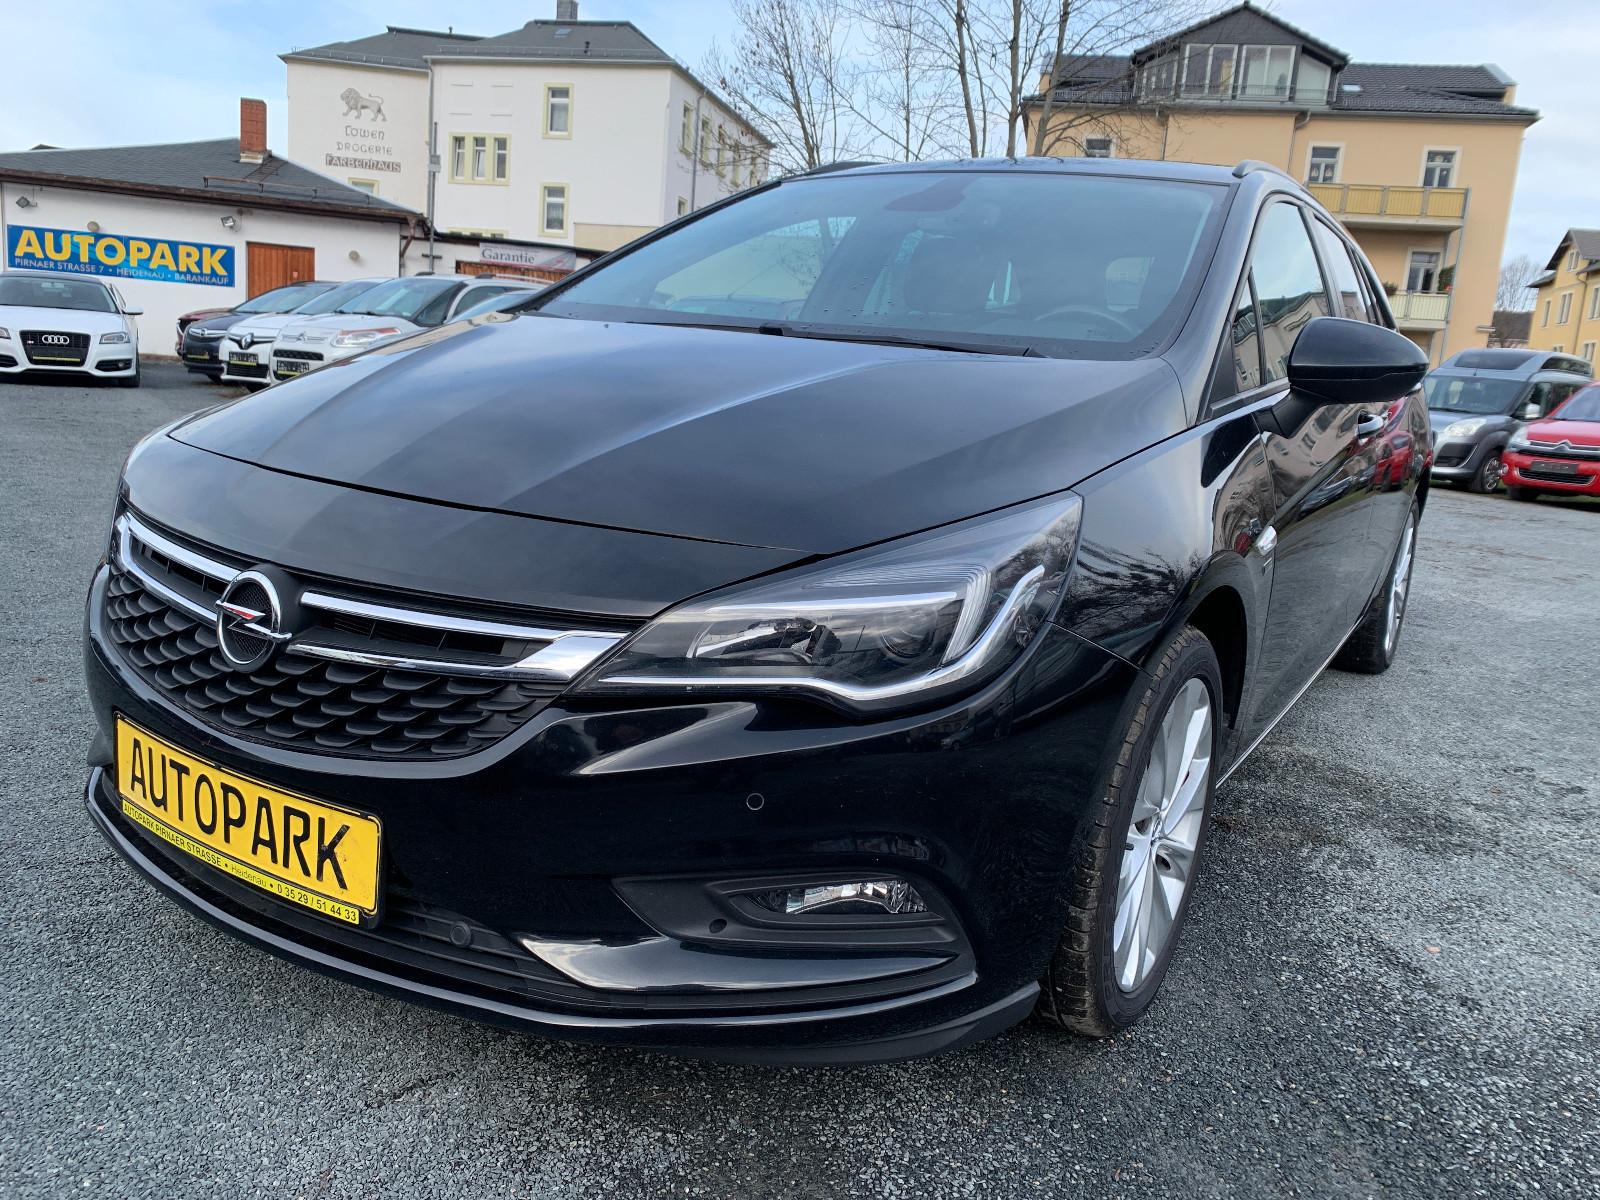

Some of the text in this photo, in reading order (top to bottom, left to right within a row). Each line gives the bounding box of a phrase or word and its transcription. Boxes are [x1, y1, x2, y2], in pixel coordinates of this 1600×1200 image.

[14, 229, 228, 275] AUTOPARK
[15, 258, 55, 269] PIRNAER
[57, 262, 96, 273] STRASSE
[116, 267, 165, 279] HEIDENAU
[174, 272, 229, 285] BARANKAUF
[481, 248, 535, 264] Garantie
[131, 737, 350, 890] AUTOPARK
[124, 803, 155, 830] AUTOPARK
[155, 824, 185, 848] PIRNAER
[186, 841, 221, 867] STRASSE
[231, 864, 267, 888] Heidenau
[285, 886, 296, 900] 35
[298, 892, 309, 904] 29
[316, 900, 327, 911] 51
[330, 904, 341, 917] 44
[345, 909, 357, 922] 33
